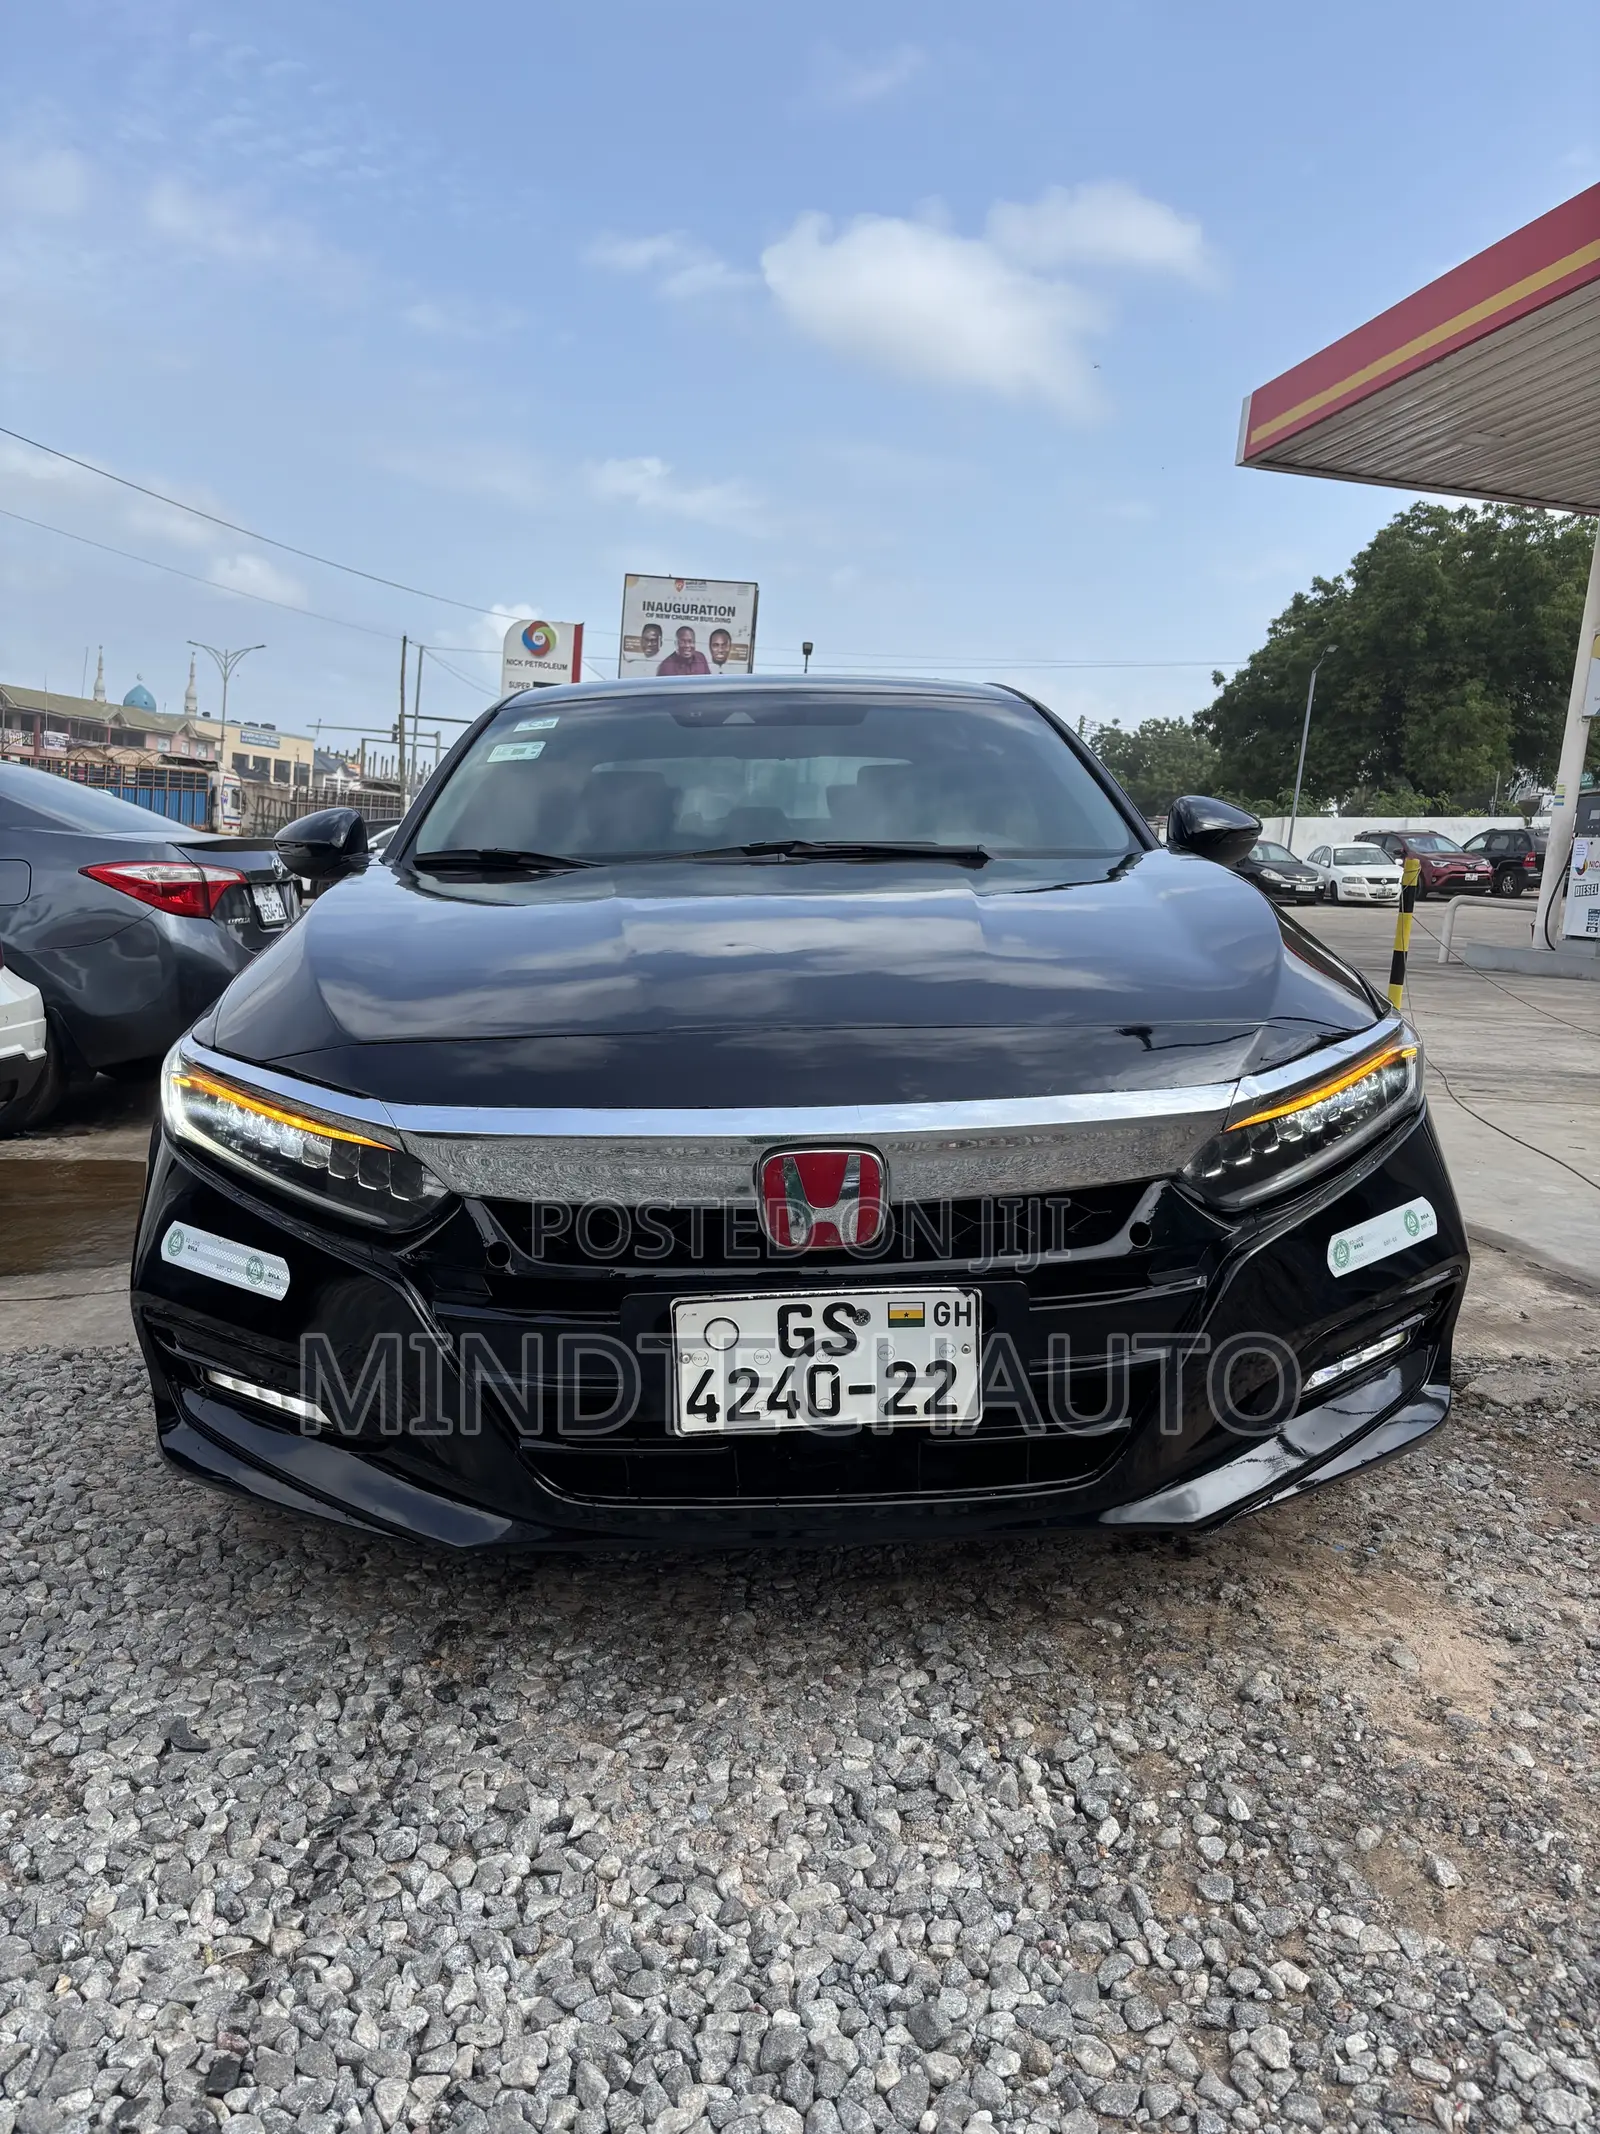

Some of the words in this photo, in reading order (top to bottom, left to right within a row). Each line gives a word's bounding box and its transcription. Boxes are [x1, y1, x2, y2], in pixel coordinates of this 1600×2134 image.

[642, 600, 736, 618] INAUGURATION
[671, 614, 699, 623] CHURCH
[700, 616, 732, 624] BUILDING
[506, 658, 523, 667] NICK
[524, 659, 568, 671] PETROLEUM
[508, 681, 531, 689] SUPER
[1575, 883, 1598, 896] DIESEL
[933, 1301, 972, 1327] GH
[777, 1302, 858, 1358] GS
[686, 1359, 958, 1423] 4240-22
